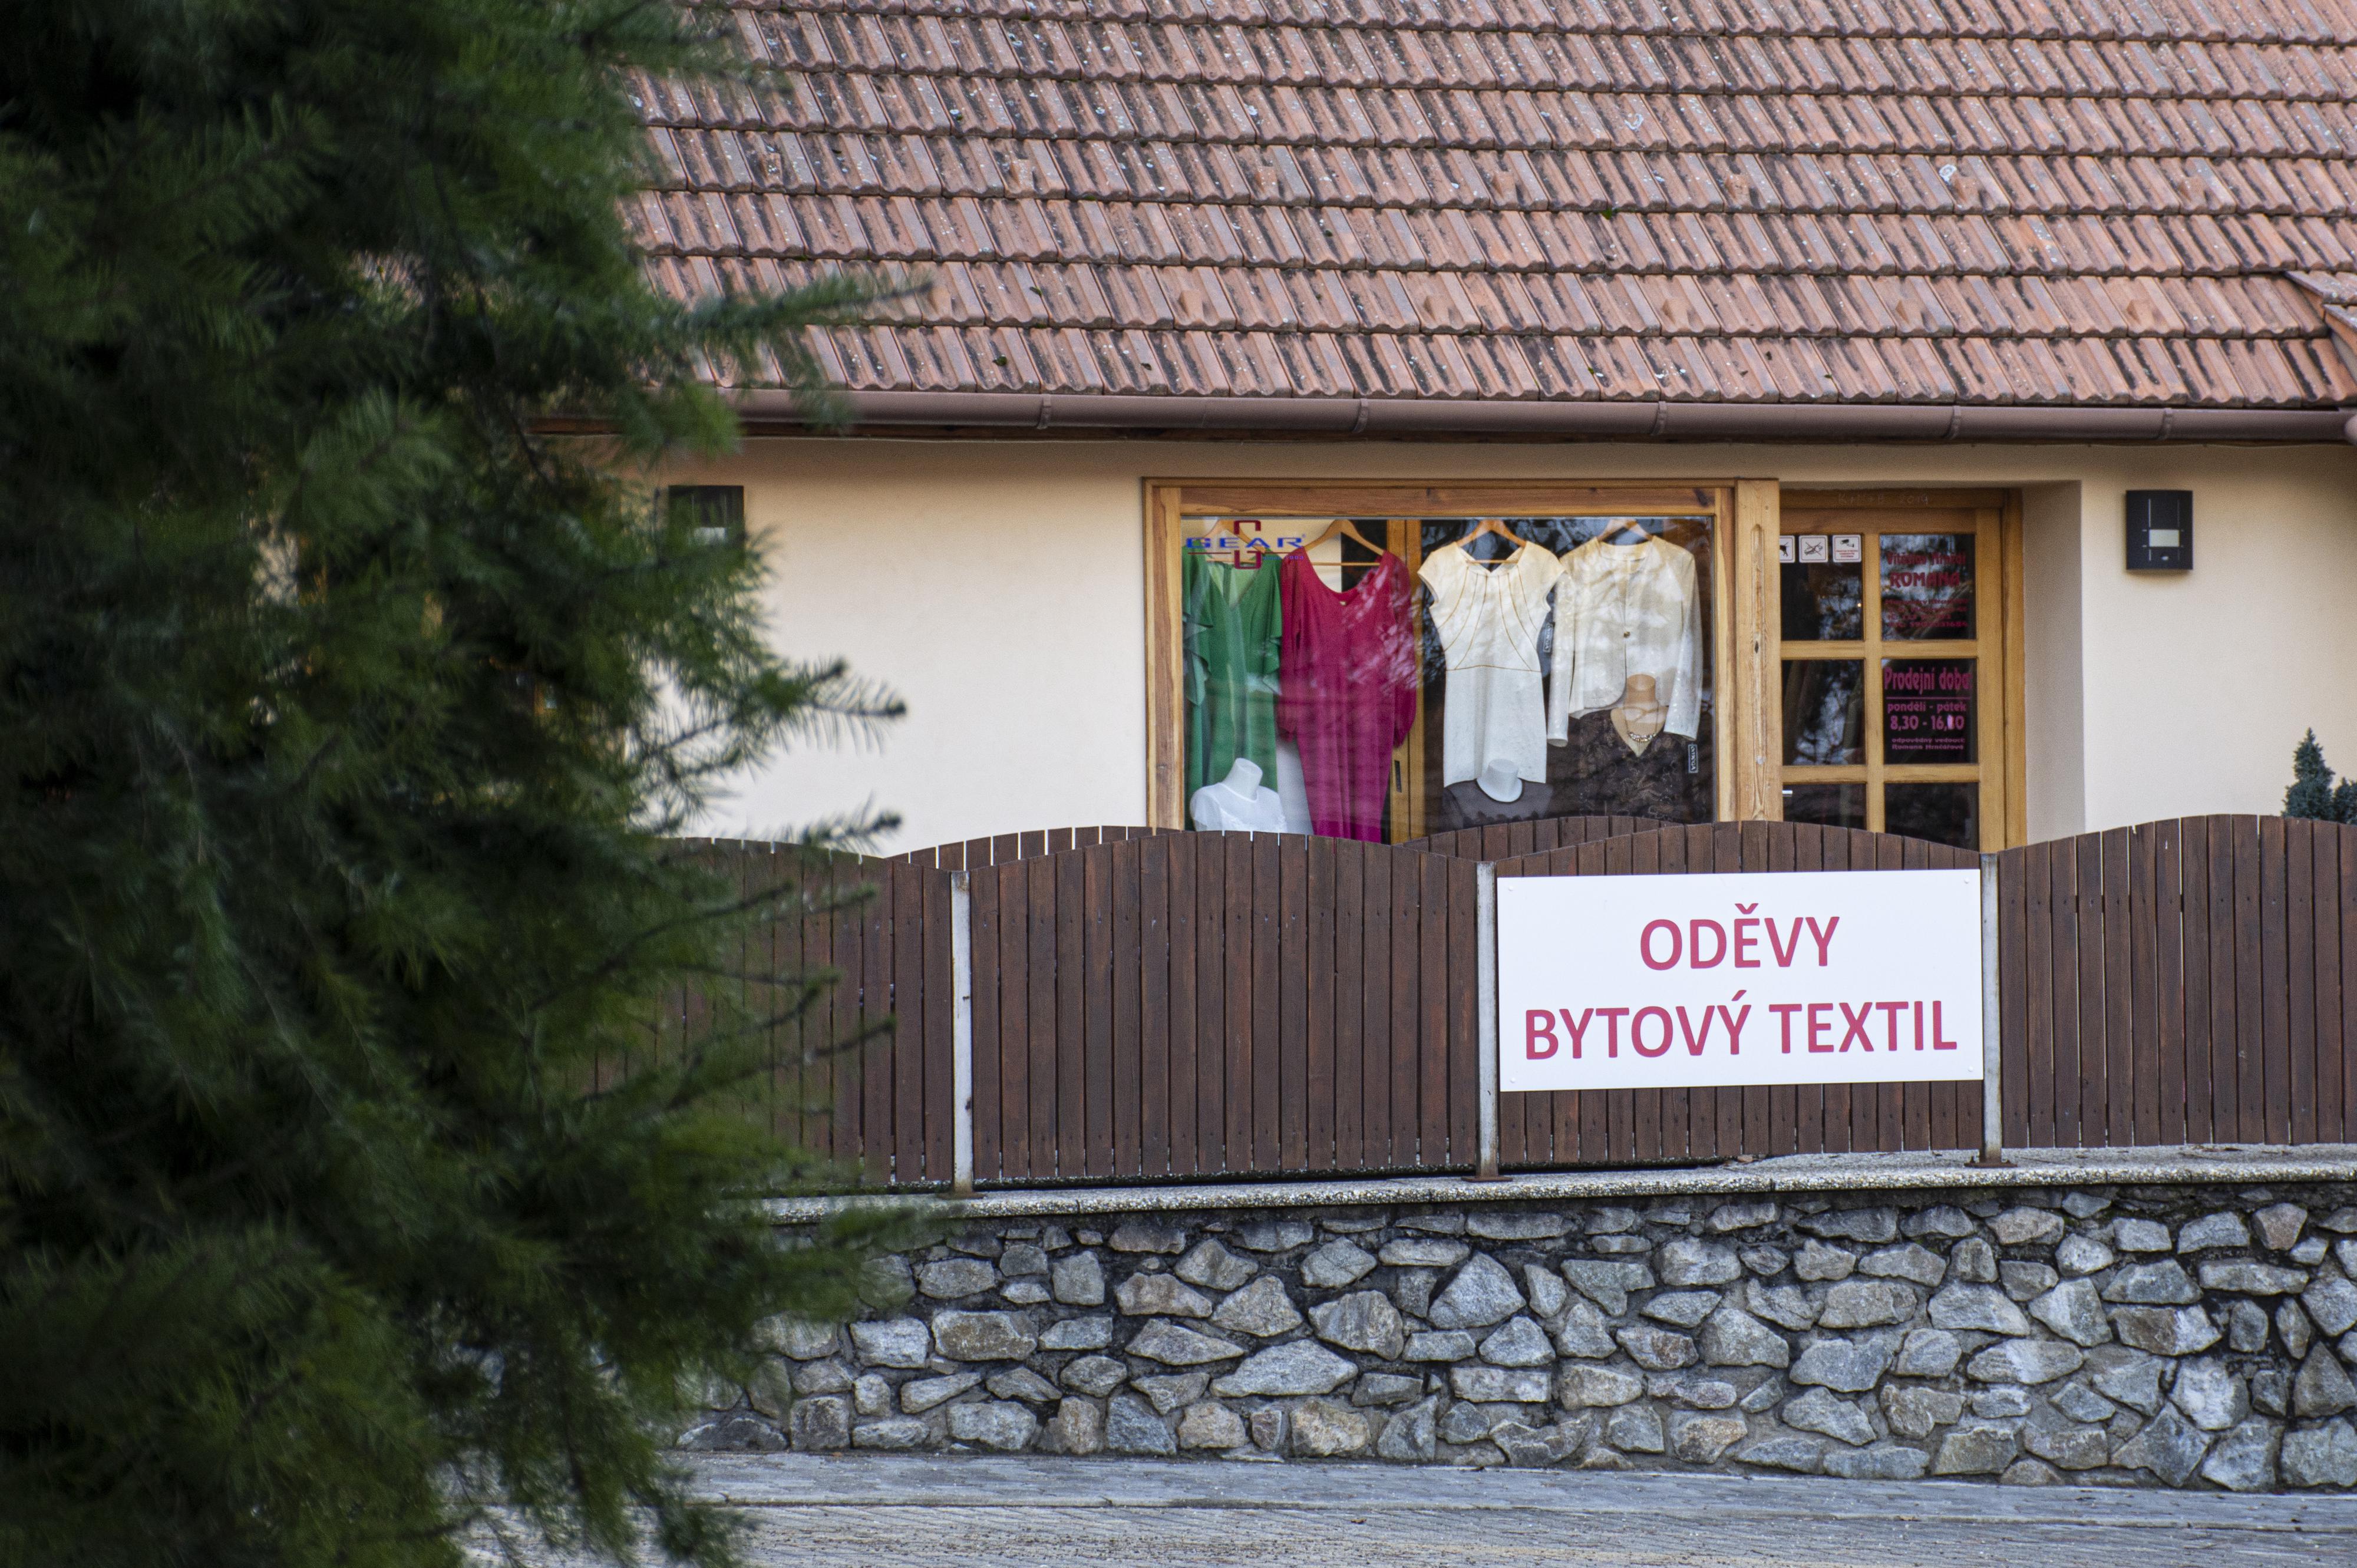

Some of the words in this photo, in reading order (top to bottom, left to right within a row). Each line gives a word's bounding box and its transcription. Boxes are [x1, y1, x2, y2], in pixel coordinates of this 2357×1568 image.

[1186, 537, 1302, 548] GEAR
[1890, 571, 1960, 588] ROMANA
[1884, 666, 1935, 695] Prodejní
[1887, 702, 1926, 714] pondělí
[1937, 701, 1966, 714] pátek
[1890, 715, 1919, 731] 8,30
[1640, 903, 1839, 970] ODĚVY
[1526, 989, 1752, 1059] BYTOVÝ
[1769, 1001, 1957, 1054] TEXTIL
